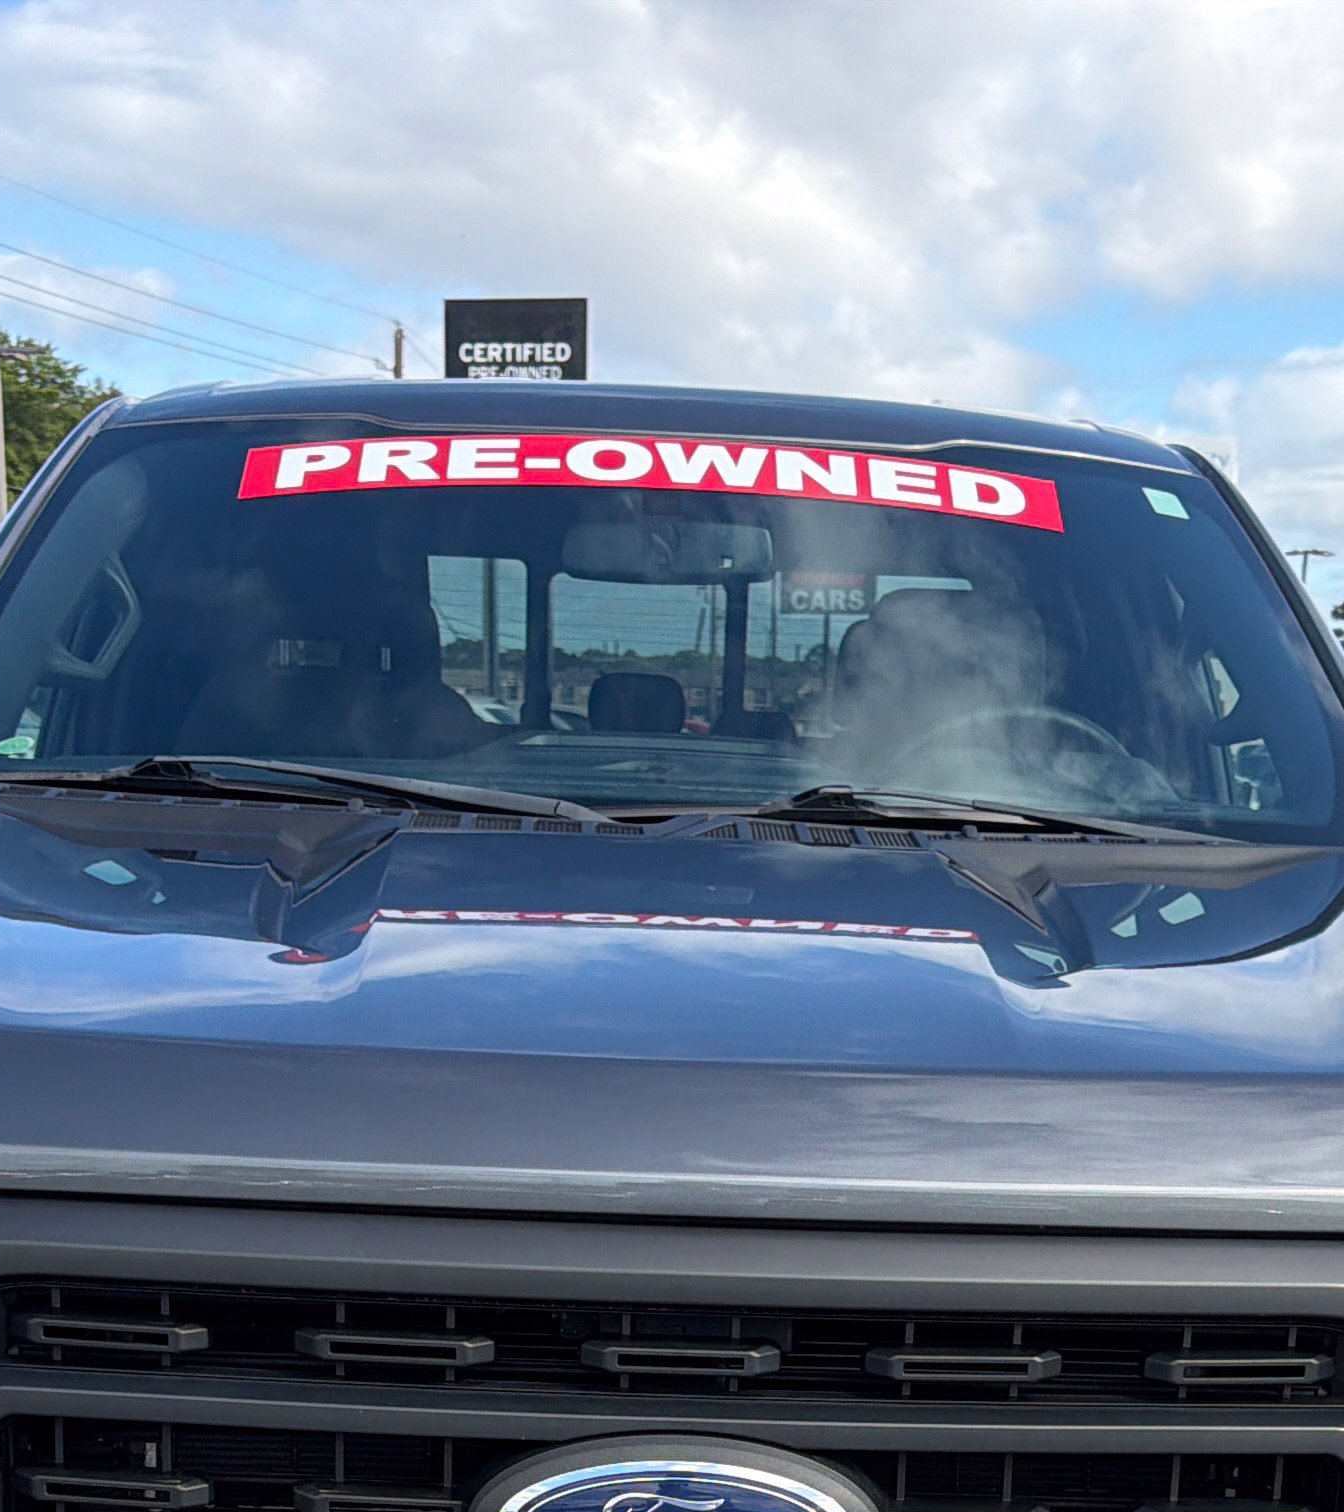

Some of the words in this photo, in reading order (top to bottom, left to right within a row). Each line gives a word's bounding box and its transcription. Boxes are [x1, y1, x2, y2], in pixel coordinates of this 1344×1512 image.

[459, 342, 572, 363] CERTIFIED
[273, 438, 1027, 517] PRE-OWNED
[791, 588, 865, 611] CARS
